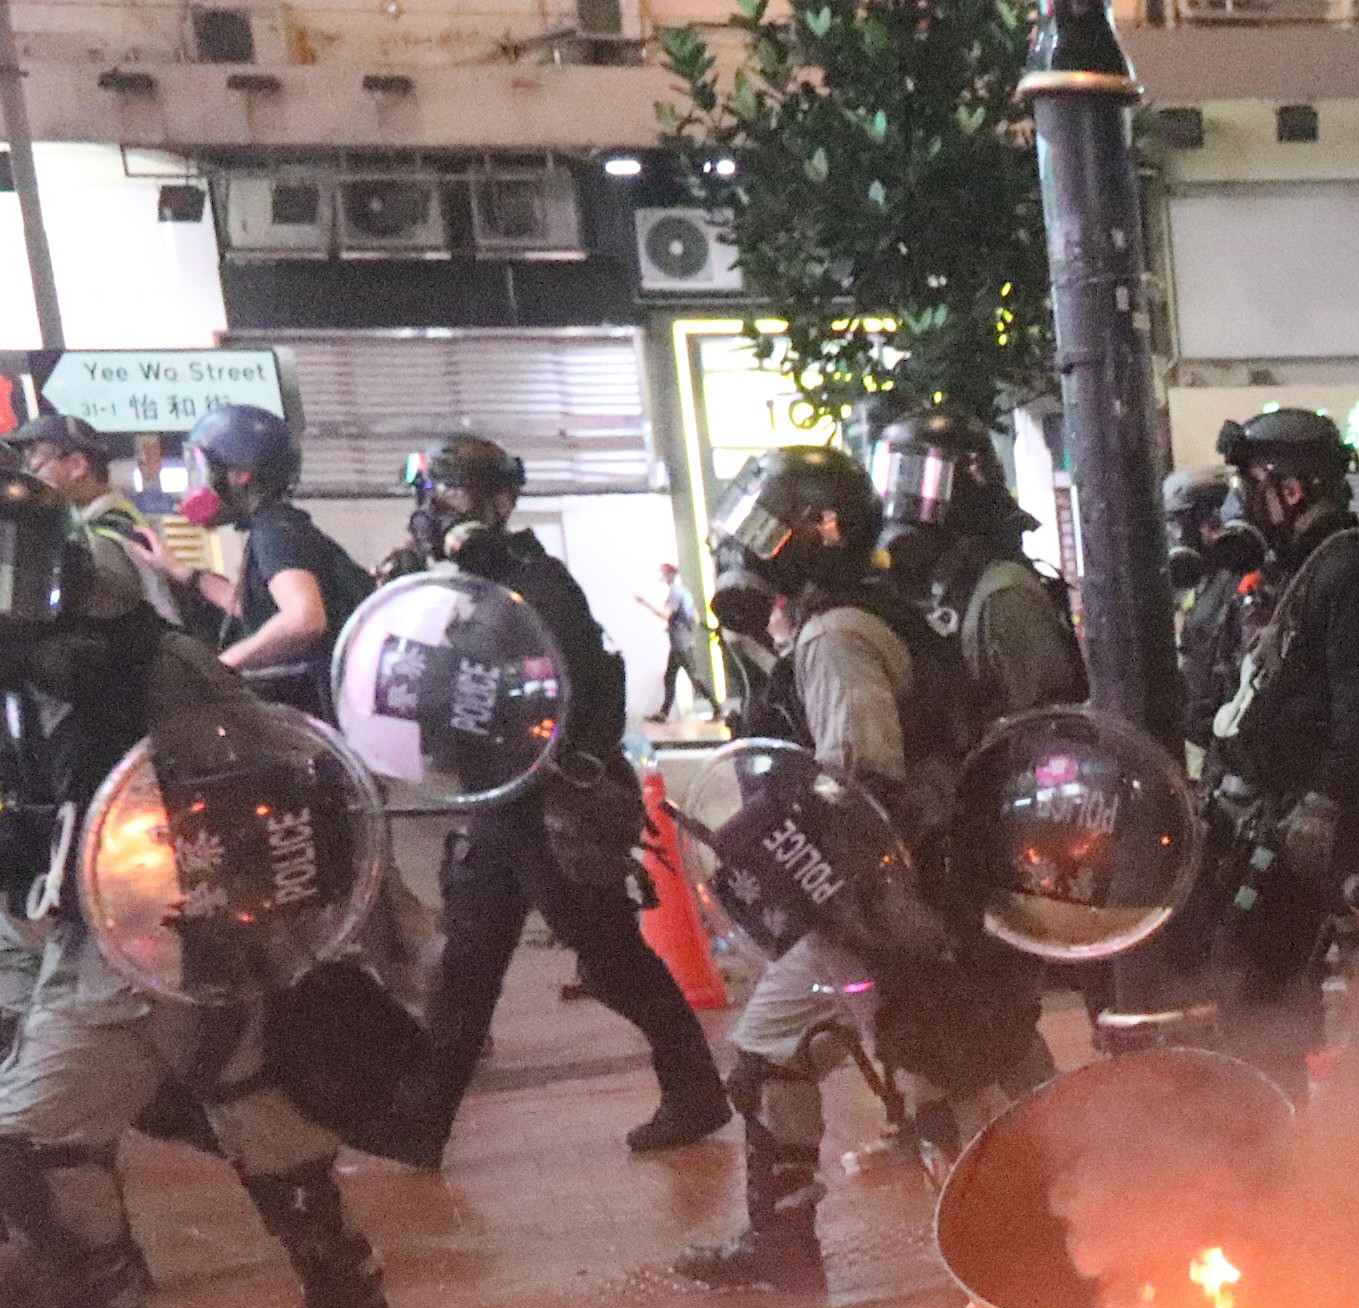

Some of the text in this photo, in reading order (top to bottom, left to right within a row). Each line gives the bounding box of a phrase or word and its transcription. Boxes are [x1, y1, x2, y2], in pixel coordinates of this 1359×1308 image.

[83, 360, 268, 382] Yee Wo Street
[451, 657, 500, 736] POLICE
[266, 807, 318, 905] POLICE
[763, 818, 845, 904] POLICE
